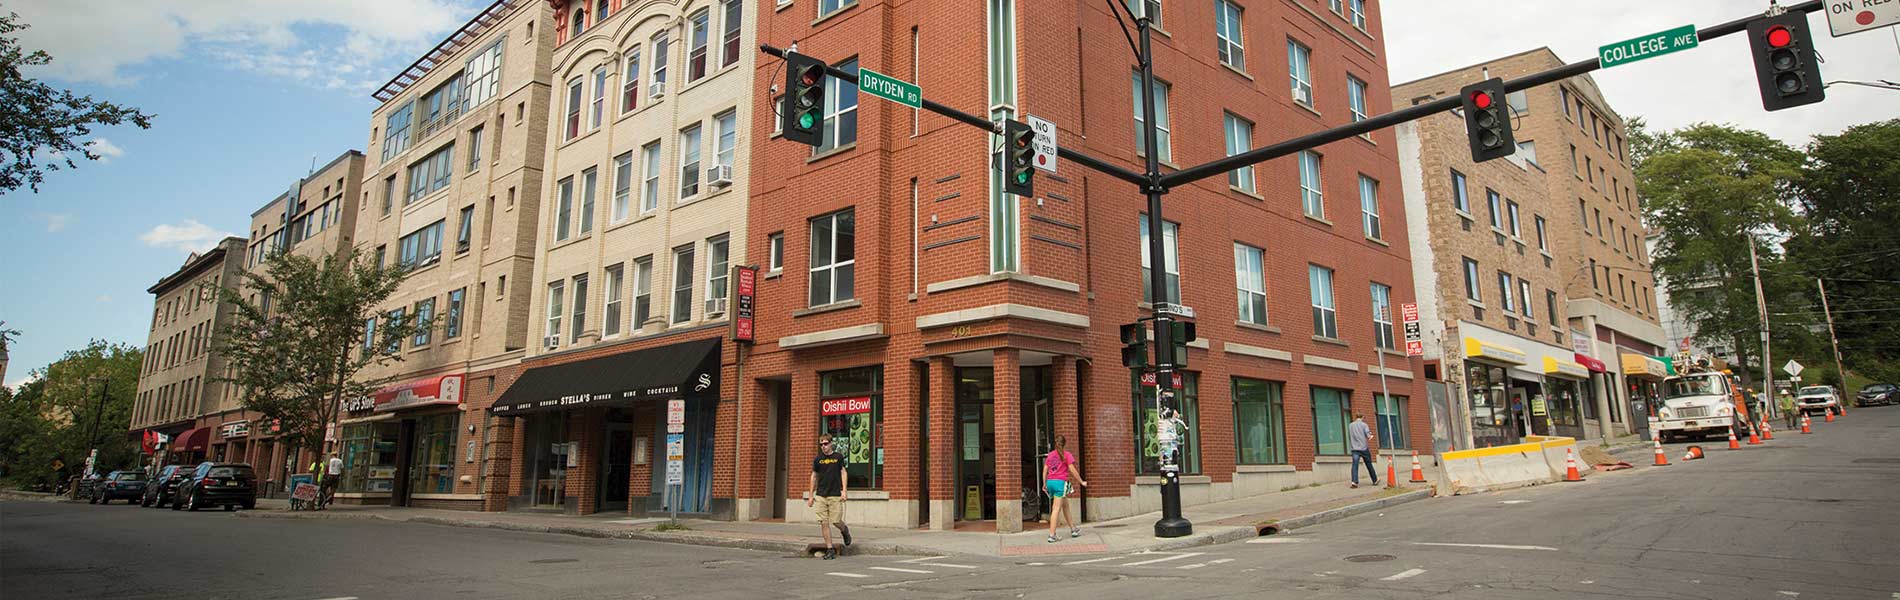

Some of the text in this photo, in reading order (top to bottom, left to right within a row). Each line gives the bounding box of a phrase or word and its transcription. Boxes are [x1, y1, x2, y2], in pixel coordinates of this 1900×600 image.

[1832, 1, 1853, 14] ON
[1603, 34, 1693, 63] COLLEGE AVE
[864, 74, 917, 103] DRYDEN RD
[1035, 121, 1048, 133] NO
[1042, 144, 1055, 156] RED
[951, 325, 971, 338] 401
[560, 393, 590, 406] STELLA'S
[623, 390, 637, 398] WINE
[646, 386, 679, 395] COCKTAILS
[823, 399, 871, 412] Oishii Bowl
